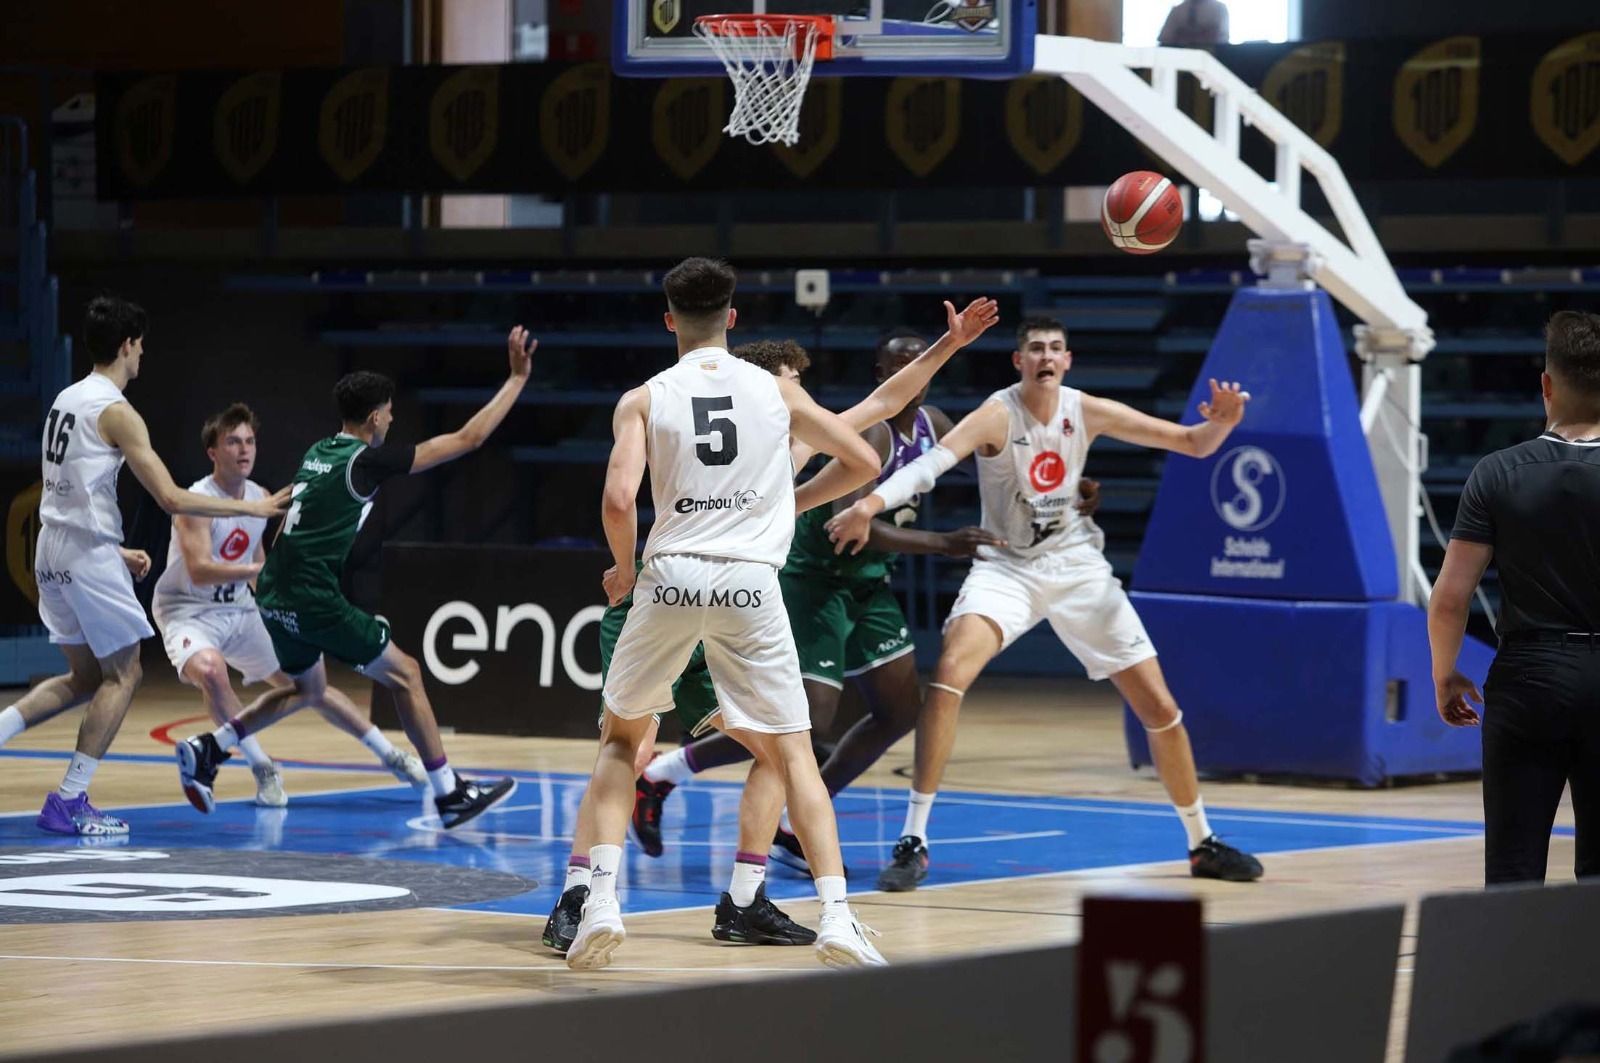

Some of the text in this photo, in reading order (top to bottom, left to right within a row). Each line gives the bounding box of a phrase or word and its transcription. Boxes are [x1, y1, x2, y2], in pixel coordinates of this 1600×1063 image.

[45, 409, 76, 465] 16
[691, 395, 738, 466] 5
[675, 495, 732, 514] embou
